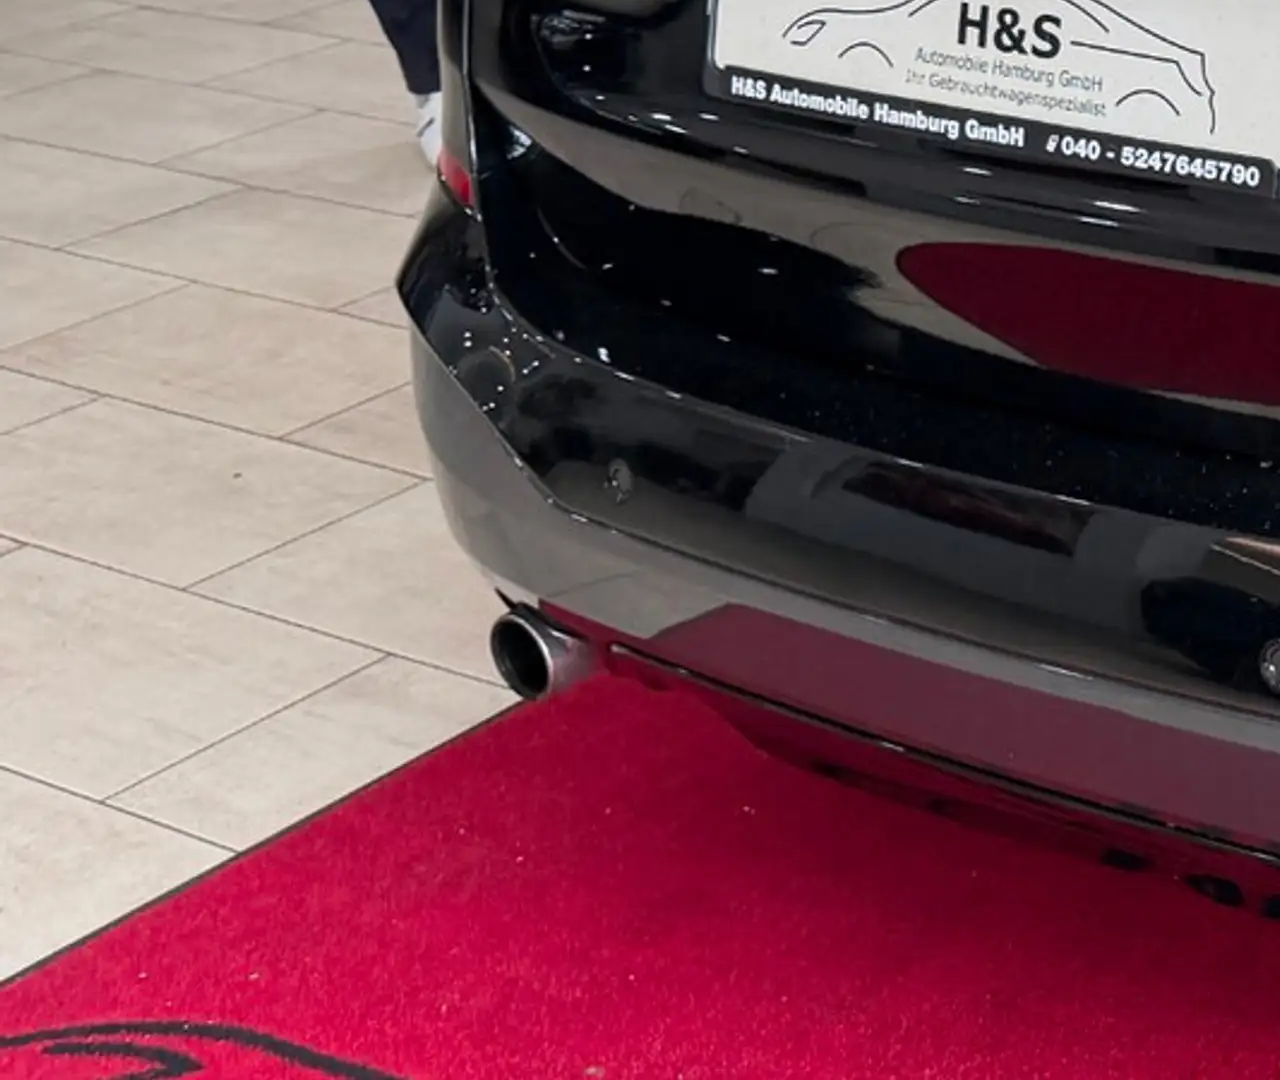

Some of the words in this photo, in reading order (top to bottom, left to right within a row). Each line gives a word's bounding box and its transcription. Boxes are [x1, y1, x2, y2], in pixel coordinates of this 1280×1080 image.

[956, 1, 1063, 60] H&S
[914, 46, 989, 73] Automobile
[990, 58, 1056, 88] Hamburg
[1057, 69, 1104, 92] GmbH
[928, 72, 1107, 118] Gebrauchtwagenspezialist
[731, 74, 767, 101] H&S
[769, 83, 870, 121] Automobile
[872, 102, 961, 140] Hamburg
[964, 119, 1025, 149] GmbH
[1060, 136, 1101, 161] 040
[1119, 146, 1261, 188] 5247645790
